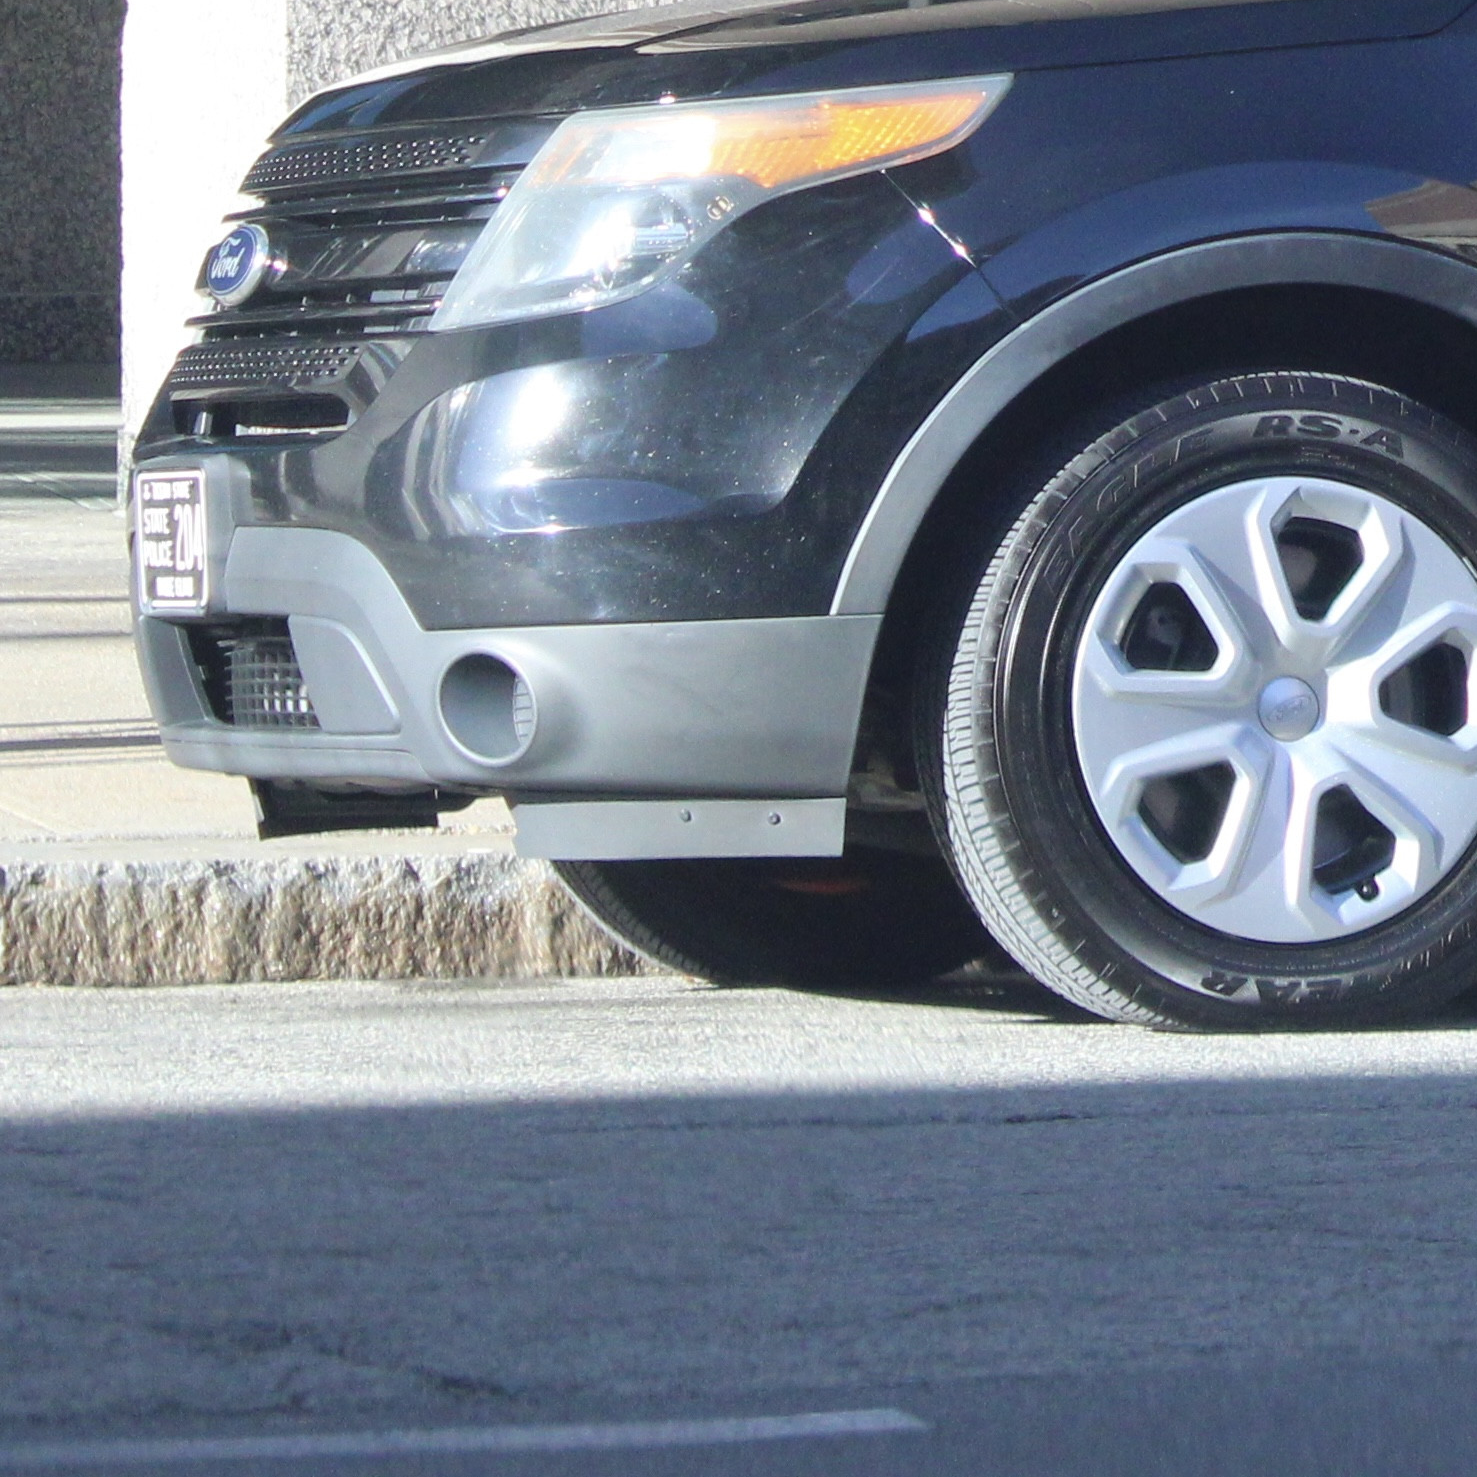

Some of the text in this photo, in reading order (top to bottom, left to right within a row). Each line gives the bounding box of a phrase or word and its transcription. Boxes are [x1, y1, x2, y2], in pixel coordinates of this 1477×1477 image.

[211, 237, 246, 279] Ford
[144, 507, 170, 534] STATE
[144, 540, 174, 567] POLICE
